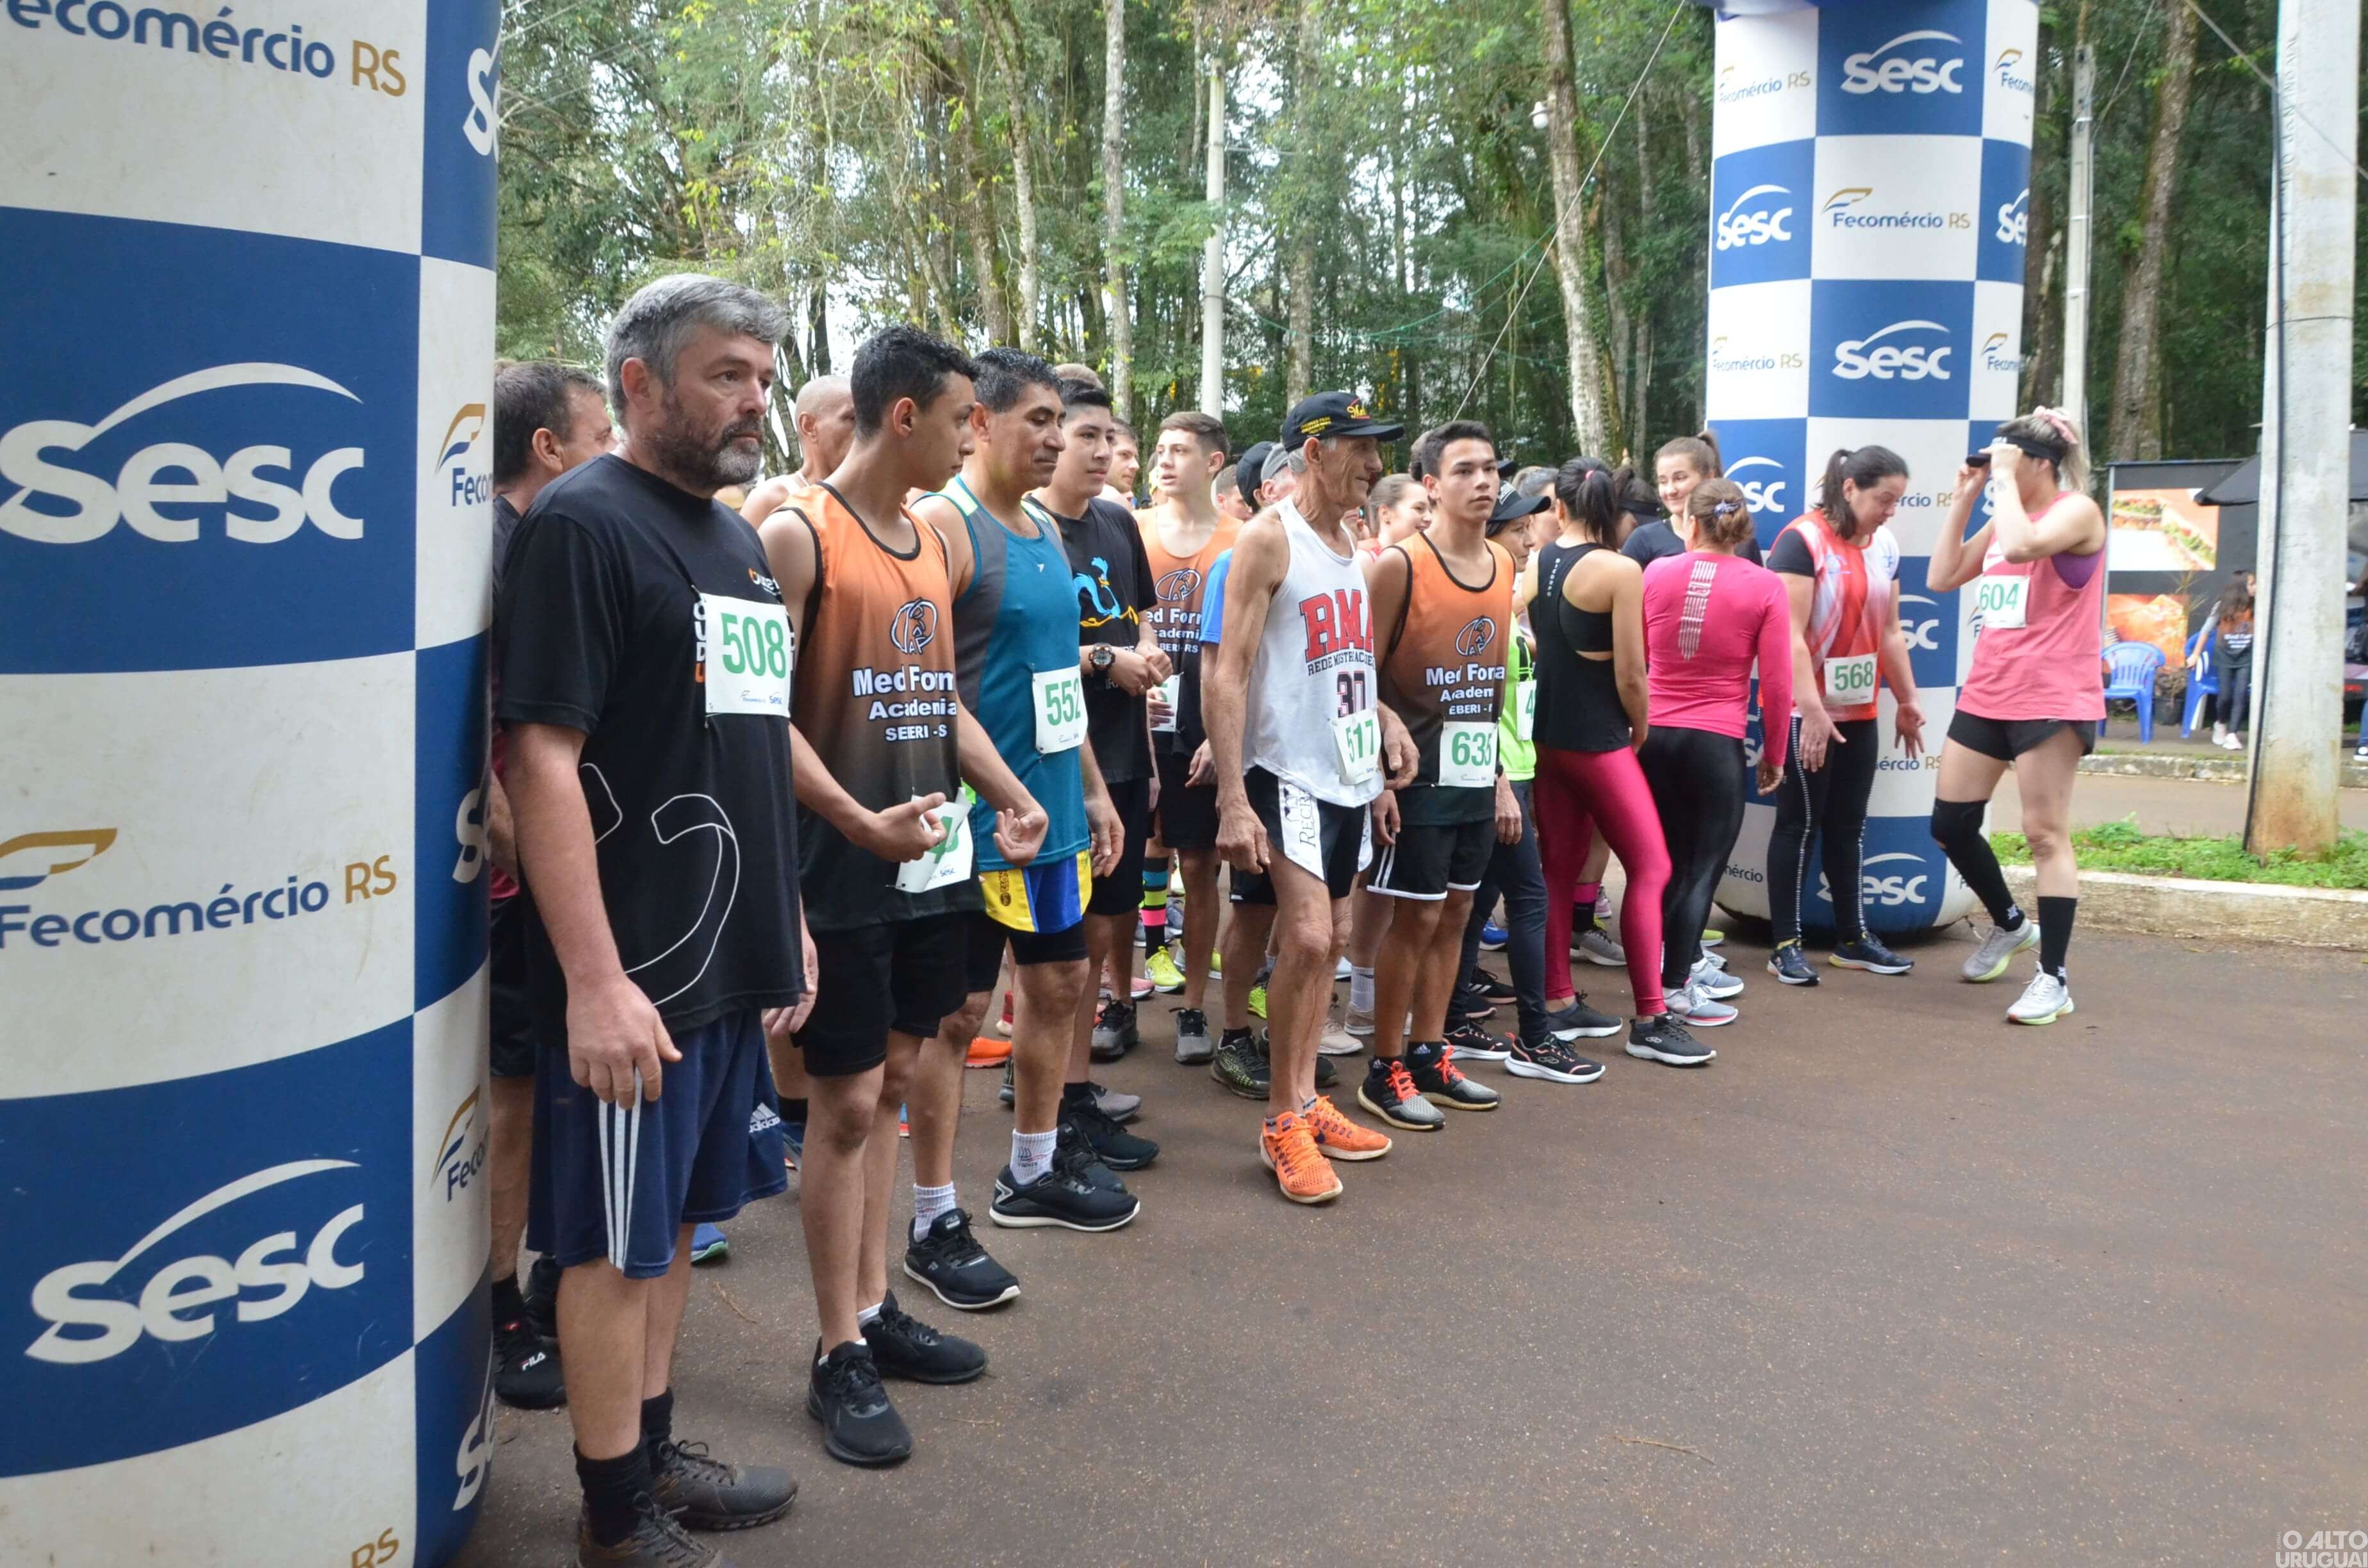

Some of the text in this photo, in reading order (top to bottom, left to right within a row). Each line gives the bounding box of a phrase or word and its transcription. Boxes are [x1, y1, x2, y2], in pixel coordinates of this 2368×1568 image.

[6, 0, 407, 97] ecomércio RS
[1788, 70, 1811, 89] RS
[1840, 53, 1963, 95] Sesc
[1716, 208, 1792, 250] Sesc
[1833, 210, 1970, 229] Fecomércio RS
[1780, 354, 1803, 368] RS
[1832, 339, 1951, 380] Sesc
[0, 420, 364, 543] Sesc
[1980, 584, 2019, 610] 604
[721, 612, 787, 679] 508
[1308, 657, 1333, 676] REDE
[1835, 661, 1873, 690] 568
[1045, 678, 1081, 726] 552
[1345, 719, 1374, 763] 517
[345, 855, 397, 904] RS
[25, 1204, 363, 1364] Sesc
[522, 1352, 546, 1371] FILA
[352, 1527, 400, 1568] RS
